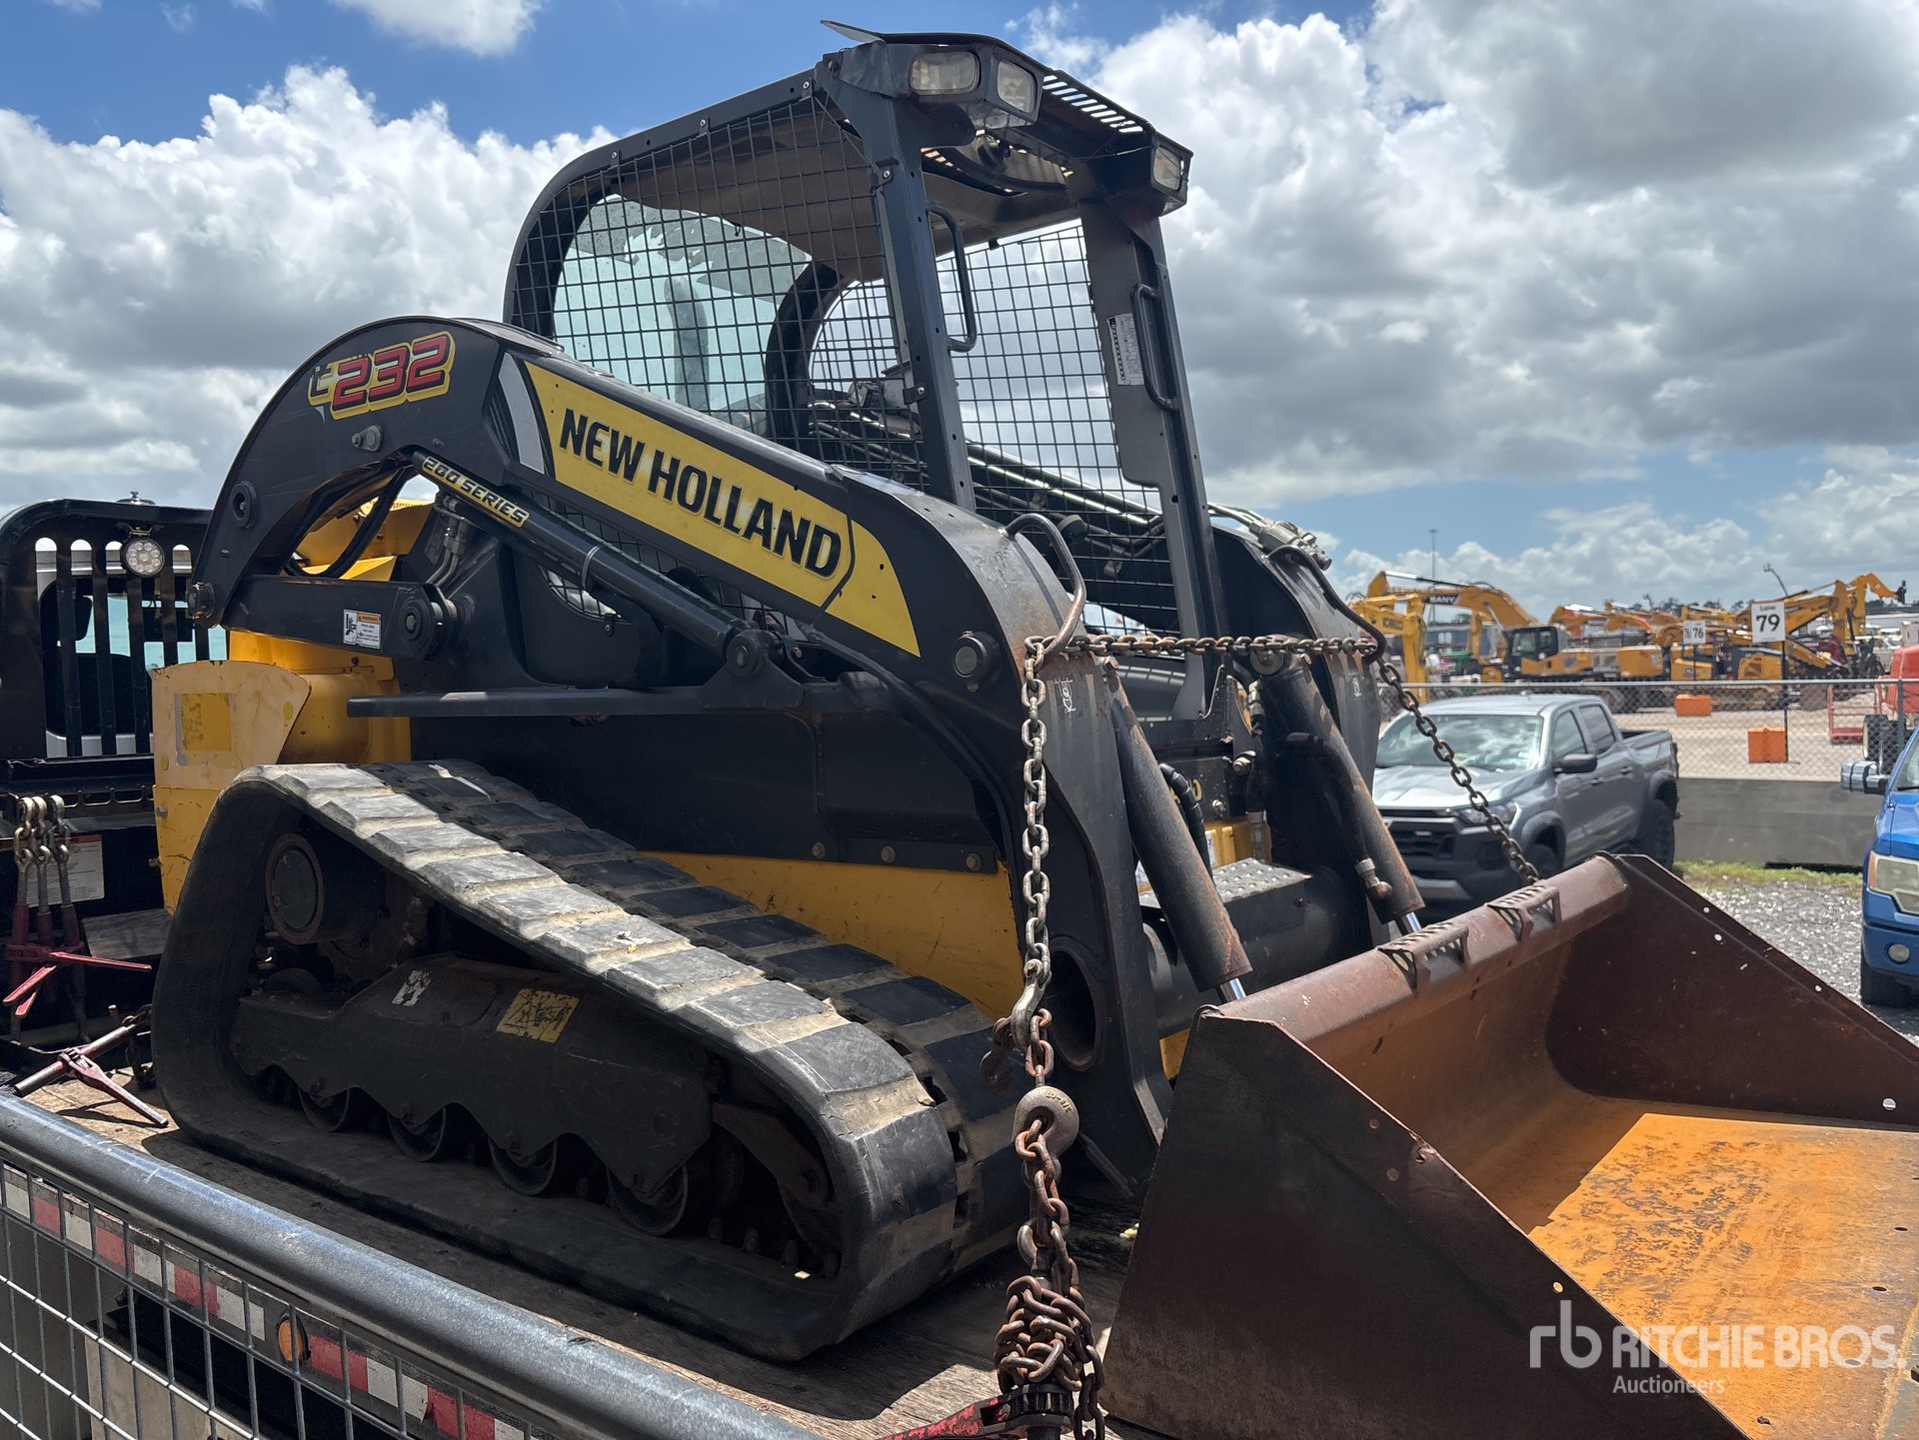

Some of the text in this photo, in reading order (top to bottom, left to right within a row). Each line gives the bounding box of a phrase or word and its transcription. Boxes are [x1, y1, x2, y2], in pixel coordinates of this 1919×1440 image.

[423, 457, 527, 522] 200 SERIES
[559, 408, 842, 578] NEW HOLLAND
[1692, 627, 1704, 639] 76
[1755, 614, 1780, 632] 79
